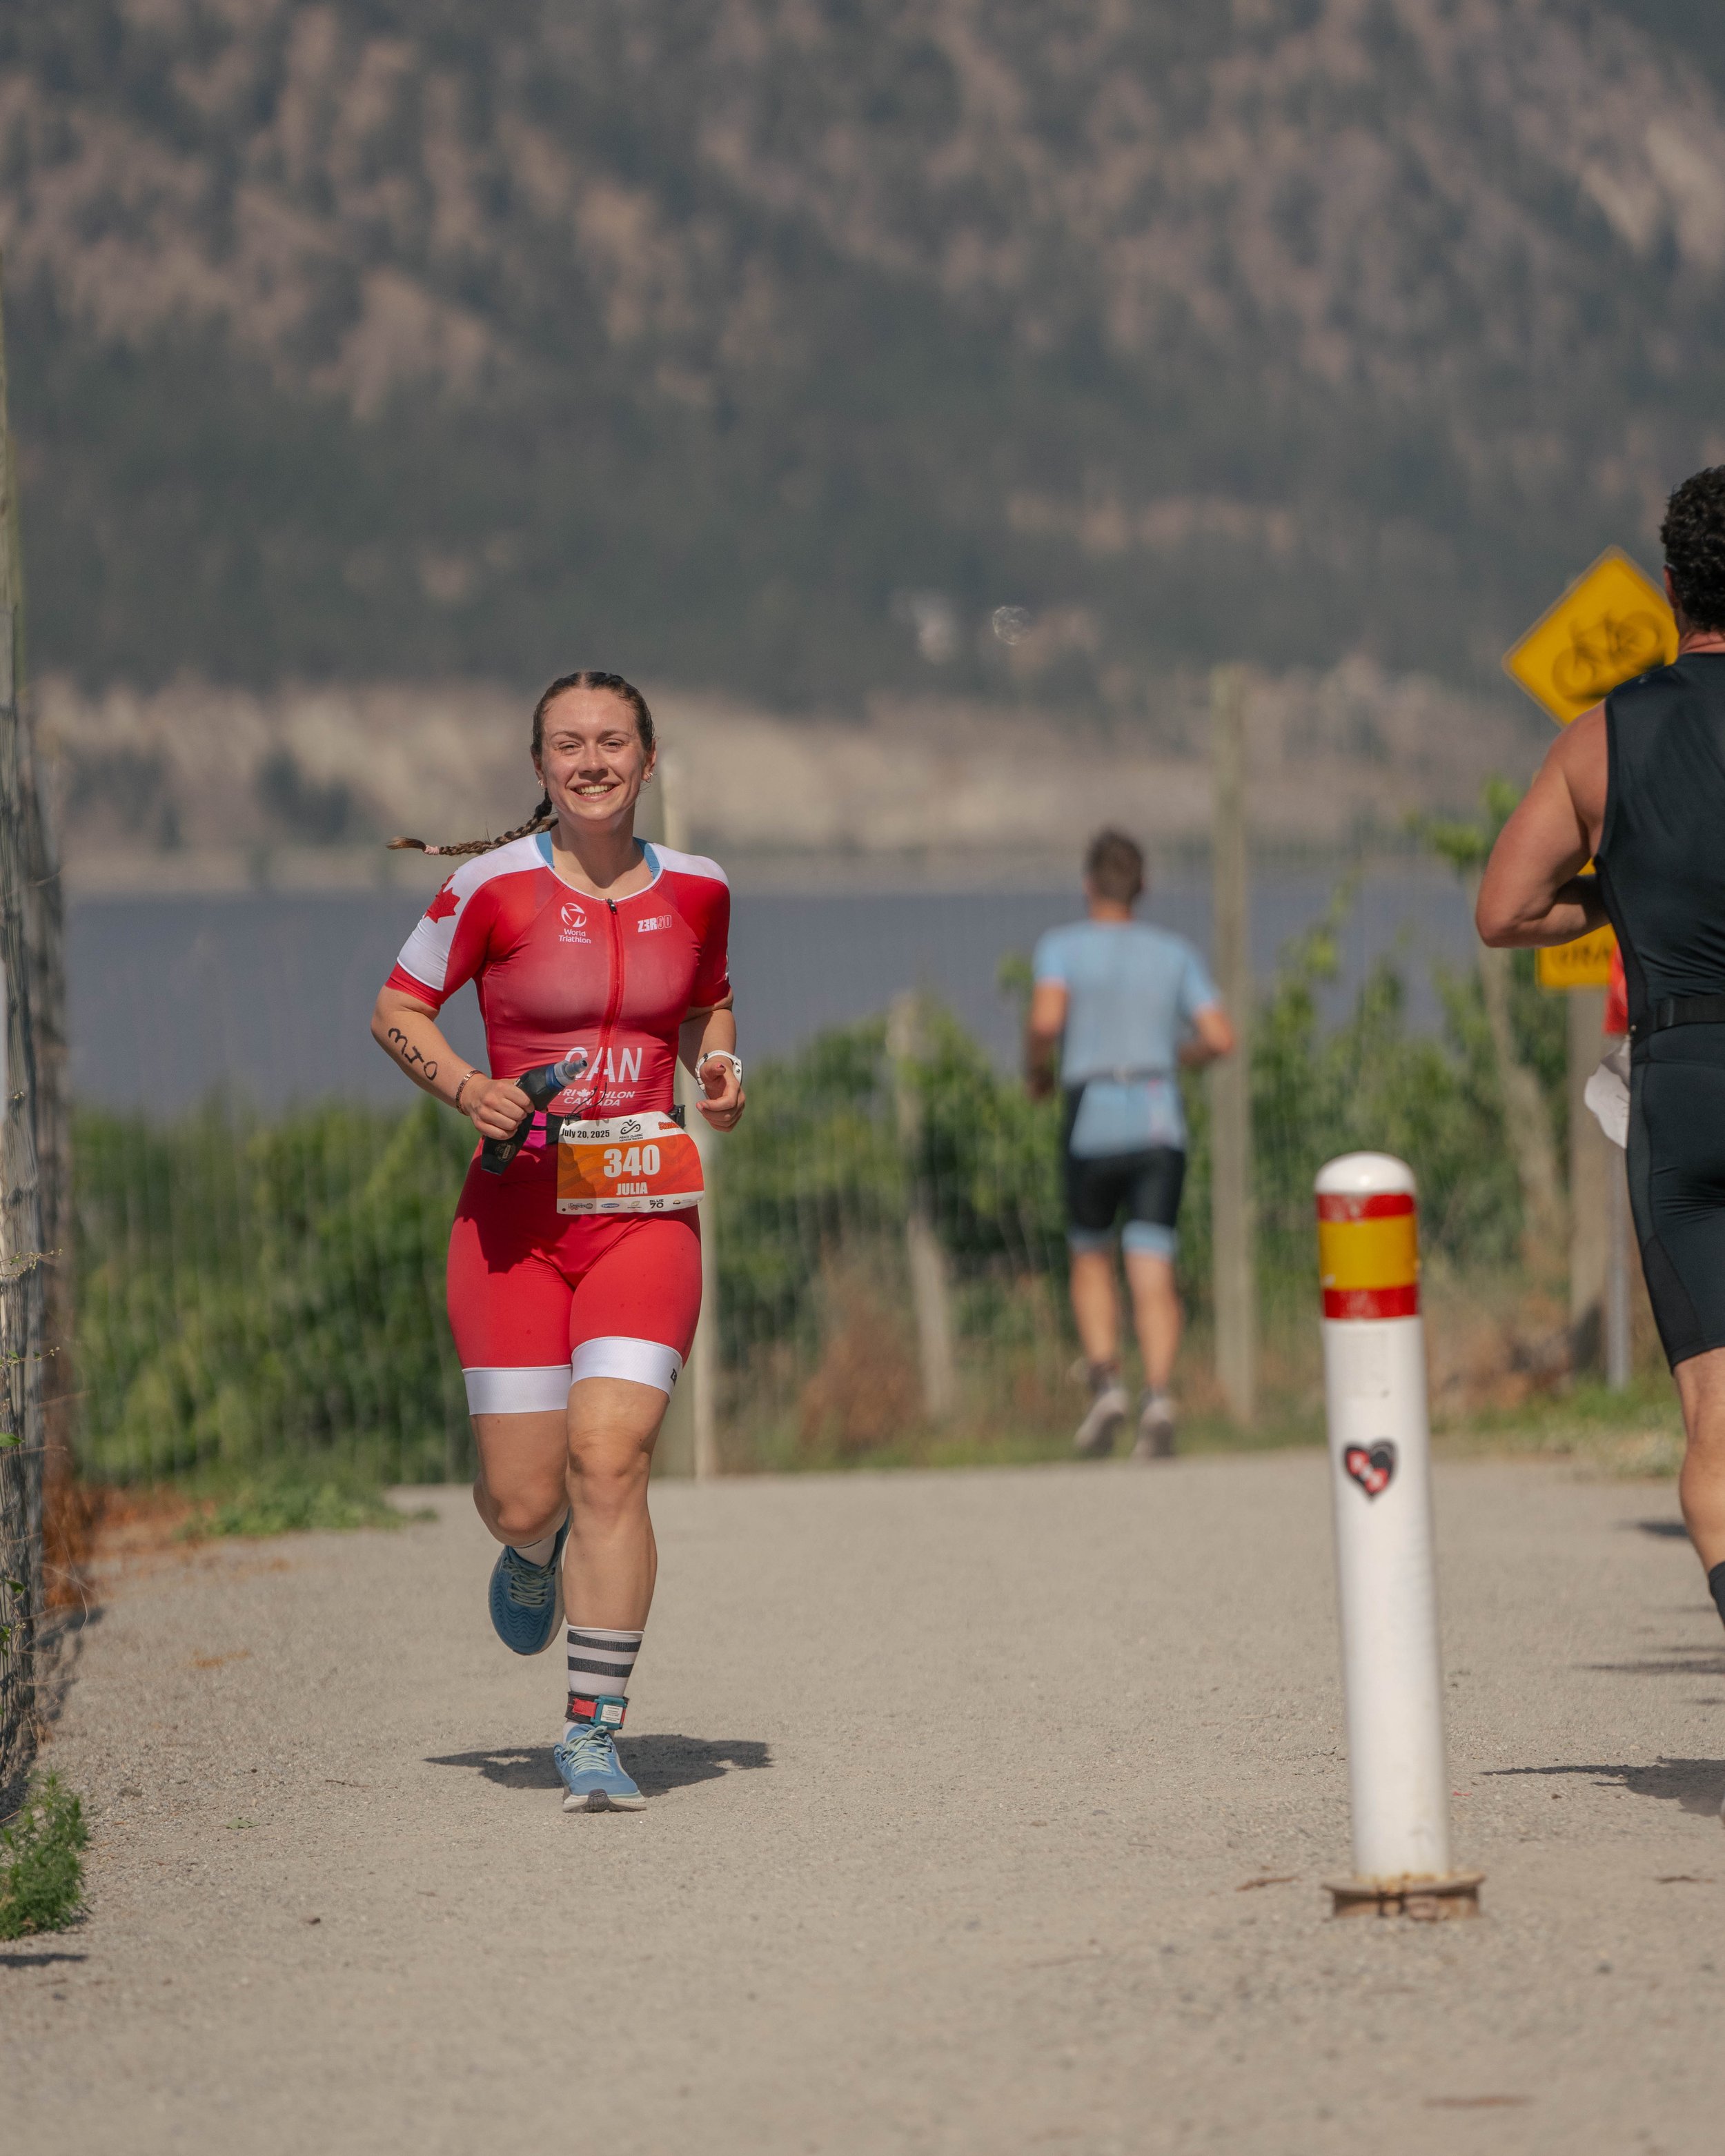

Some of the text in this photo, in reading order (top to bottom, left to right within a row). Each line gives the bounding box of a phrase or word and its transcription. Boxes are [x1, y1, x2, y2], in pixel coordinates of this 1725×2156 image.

[558, 935, 591, 944] Triathlon
[564, 928, 586, 937] World
[388, 1028, 437, 1080] 340
[564, 1047, 642, 1082] CAN
[561, 1129, 575, 1138] July
[603, 1145, 660, 1177] 340
[616, 1182, 648, 1196] JULIA
